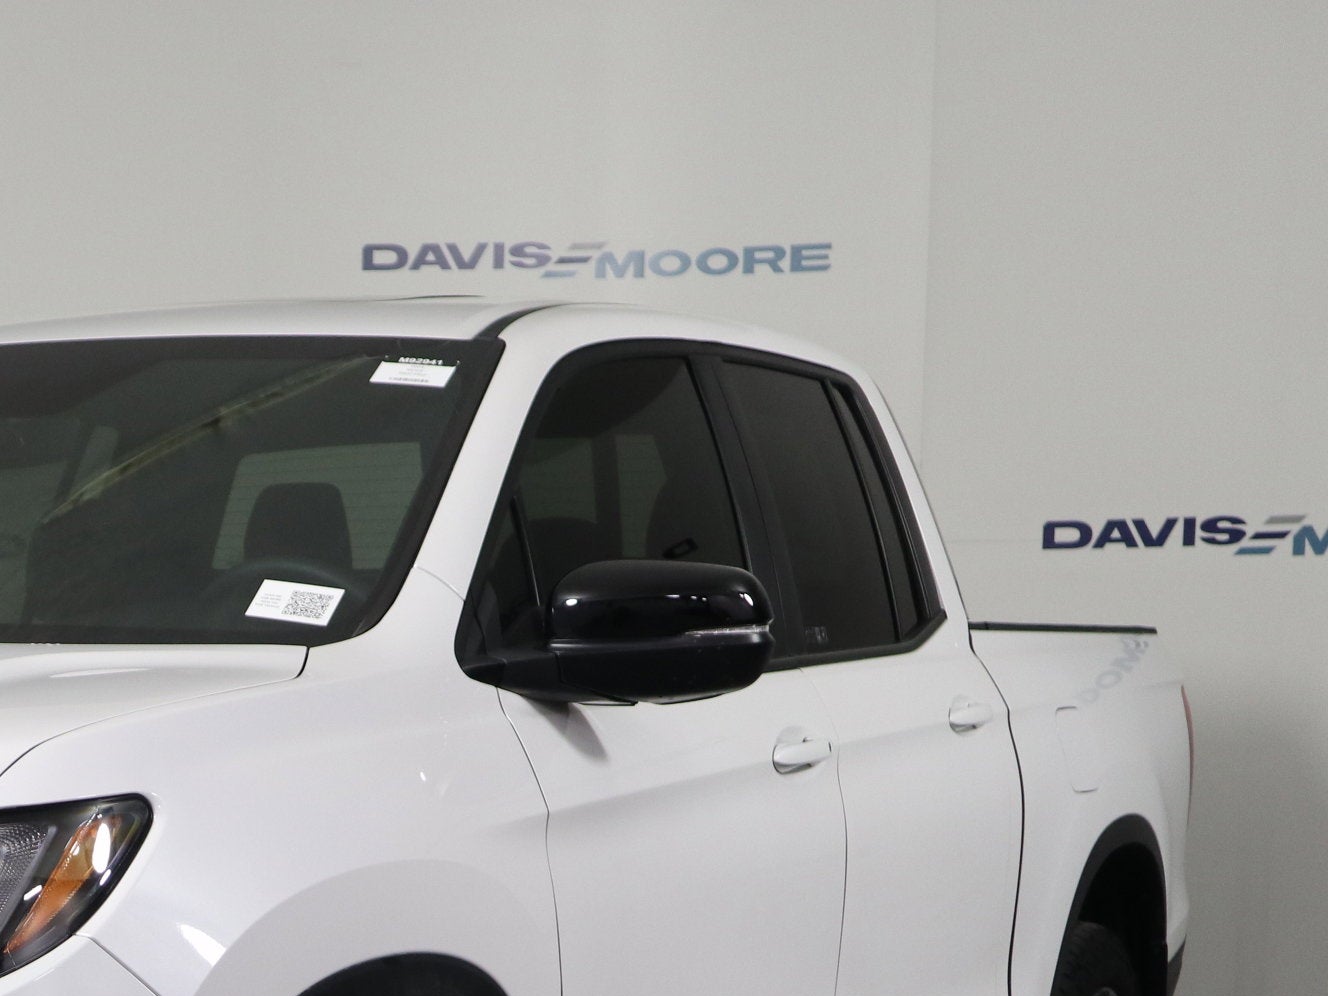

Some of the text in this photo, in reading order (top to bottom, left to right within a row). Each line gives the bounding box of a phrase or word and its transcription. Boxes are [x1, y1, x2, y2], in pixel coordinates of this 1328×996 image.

[361, 241, 833, 279] DAVIS MOORE
[1042, 515, 1247, 549] DAVIS
